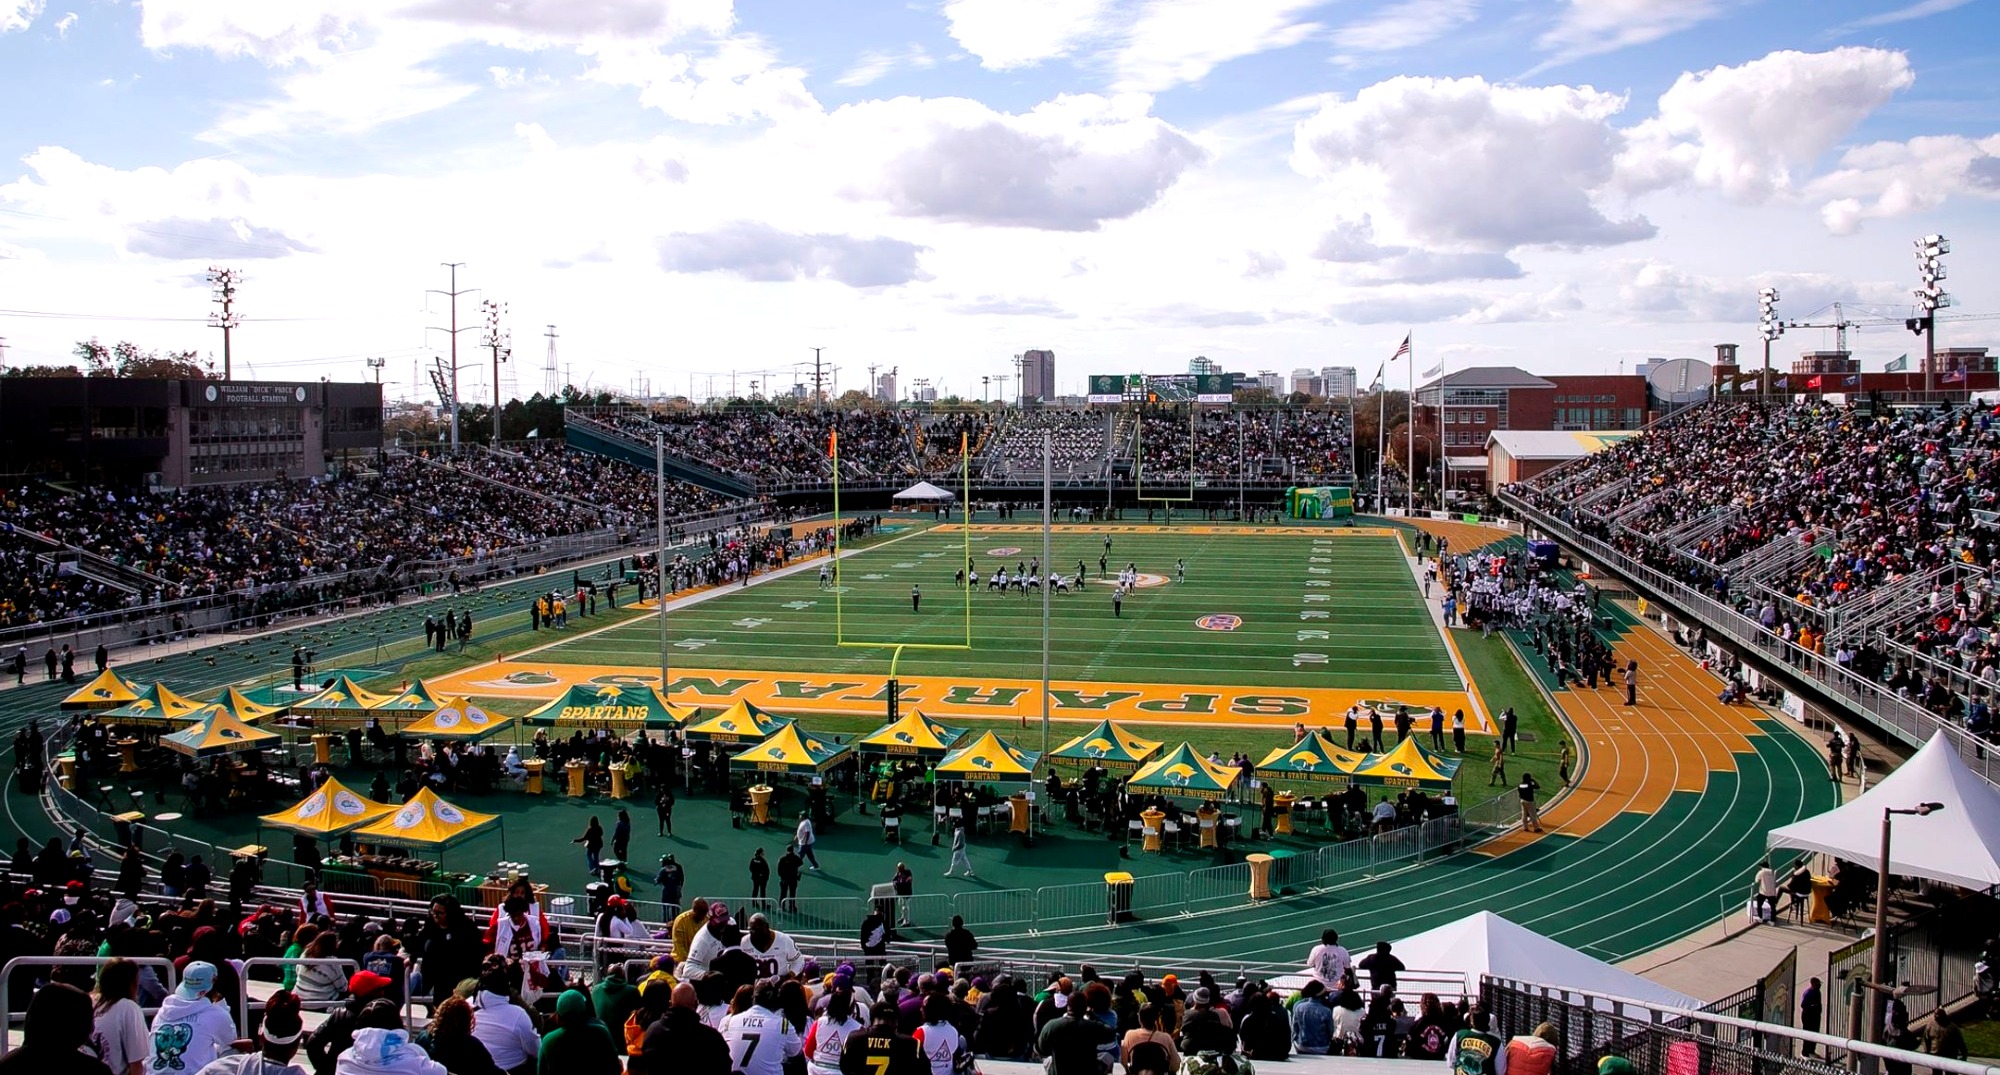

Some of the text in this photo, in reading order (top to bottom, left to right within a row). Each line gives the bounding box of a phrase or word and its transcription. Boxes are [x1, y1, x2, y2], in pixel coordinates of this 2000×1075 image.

[261, 395, 288, 403] STADIUM
[559, 705, 649, 720] SPARTANS
[709, 733, 739, 742] SPARTANS
[886, 745, 918, 754] SPARTANS
[757, 762, 789, 771] SPARTANS
[1050, 756, 1138, 770] NORFOLK STATE UNIVERSITY
[964, 772, 1000, 781] SPARTANS
[1256, 769, 1350, 783] NORFOLK STATE UNIVERSITY
[1383, 777, 1420, 787] SPARTANS
[1129, 785, 1225, 799] NORFOLK STATE UNIVERSITY
[741, 1017, 765, 1028] VICK
[826, 1042, 840, 1053] 90
[867, 1037, 892, 1049] VICK
[1374, 1035, 1386, 1057] 7
[1461, 1038, 1492, 1057] COLLEGE
[739, 1033, 761, 1068] 7
[866, 1056, 890, 1075] 7
